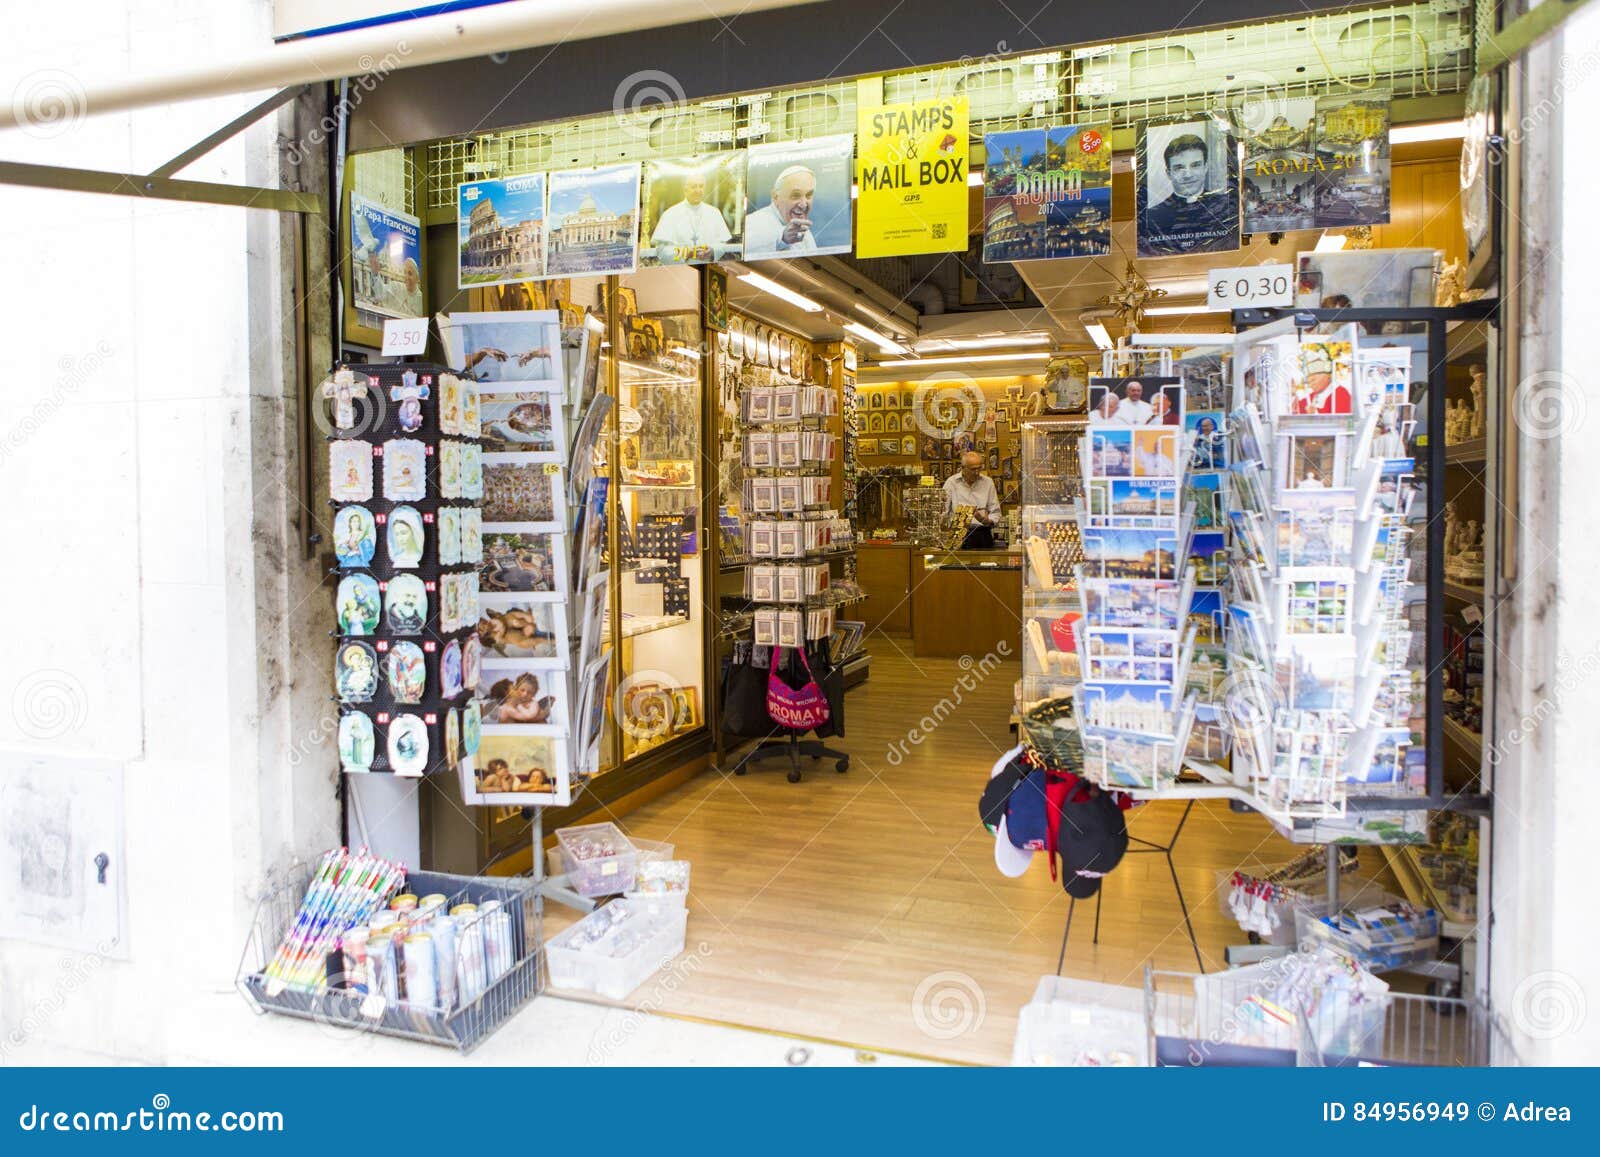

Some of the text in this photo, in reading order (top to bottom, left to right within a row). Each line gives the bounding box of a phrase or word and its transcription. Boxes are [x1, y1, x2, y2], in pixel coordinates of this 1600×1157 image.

[873, 105, 953, 138] STAMPS
[906, 138, 918, 160] &
[1256, 150, 1378, 176] ROMA 201
[505, 180, 540, 193] ROMA
[863, 158, 963, 192] MAIL BOX
[1014, 169, 1081, 206] ROMA
[1038, 203, 1055, 215] 2017
[364, 206, 417, 237] Papa Francesco
[1148, 230, 1229, 242] CALENDARIO ROMANO
[1213, 276, 1287, 301] € 0,30
[389, 330, 421, 347] 2.50
[772, 702, 815, 722] ROMA
